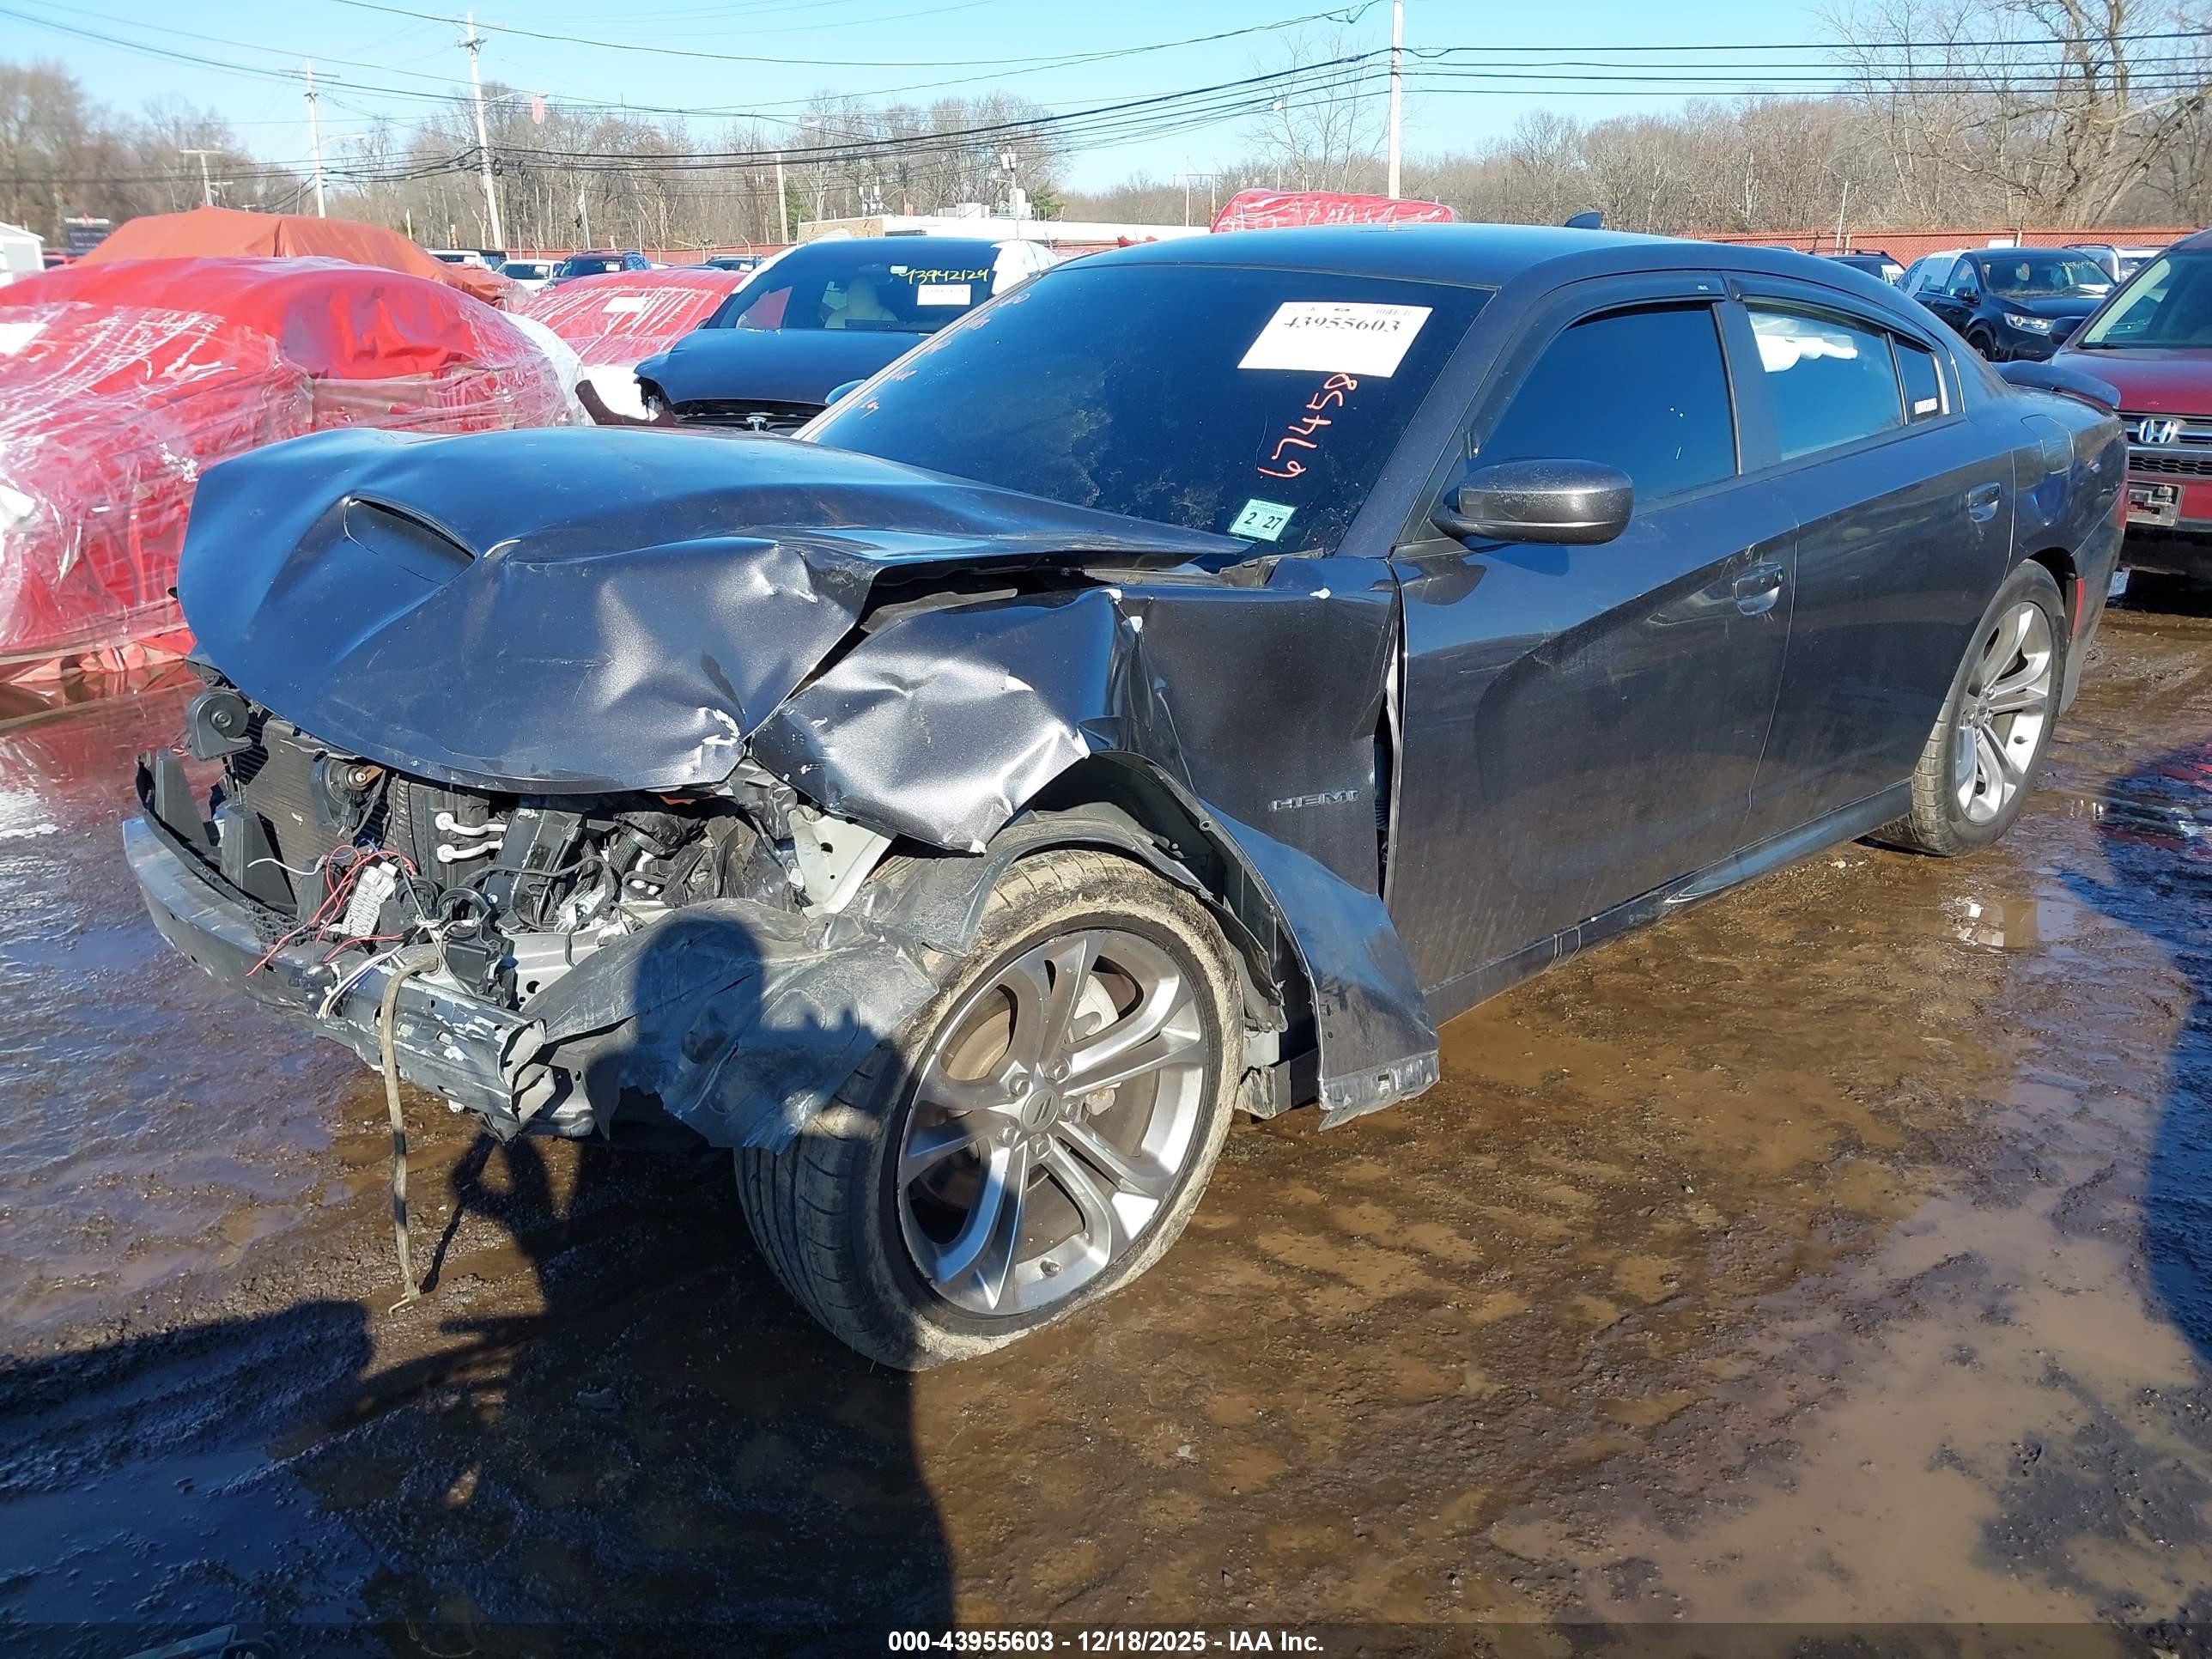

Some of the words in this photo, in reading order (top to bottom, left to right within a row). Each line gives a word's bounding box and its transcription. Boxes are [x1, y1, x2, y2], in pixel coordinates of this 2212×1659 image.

[1284, 315, 1401, 333] 43955603
[1257, 373, 1358, 477] 67458
[1243, 511, 1258, 526] 2
[1261, 515, 1285, 531] 27
[1268, 789, 1359, 812] HEMI
